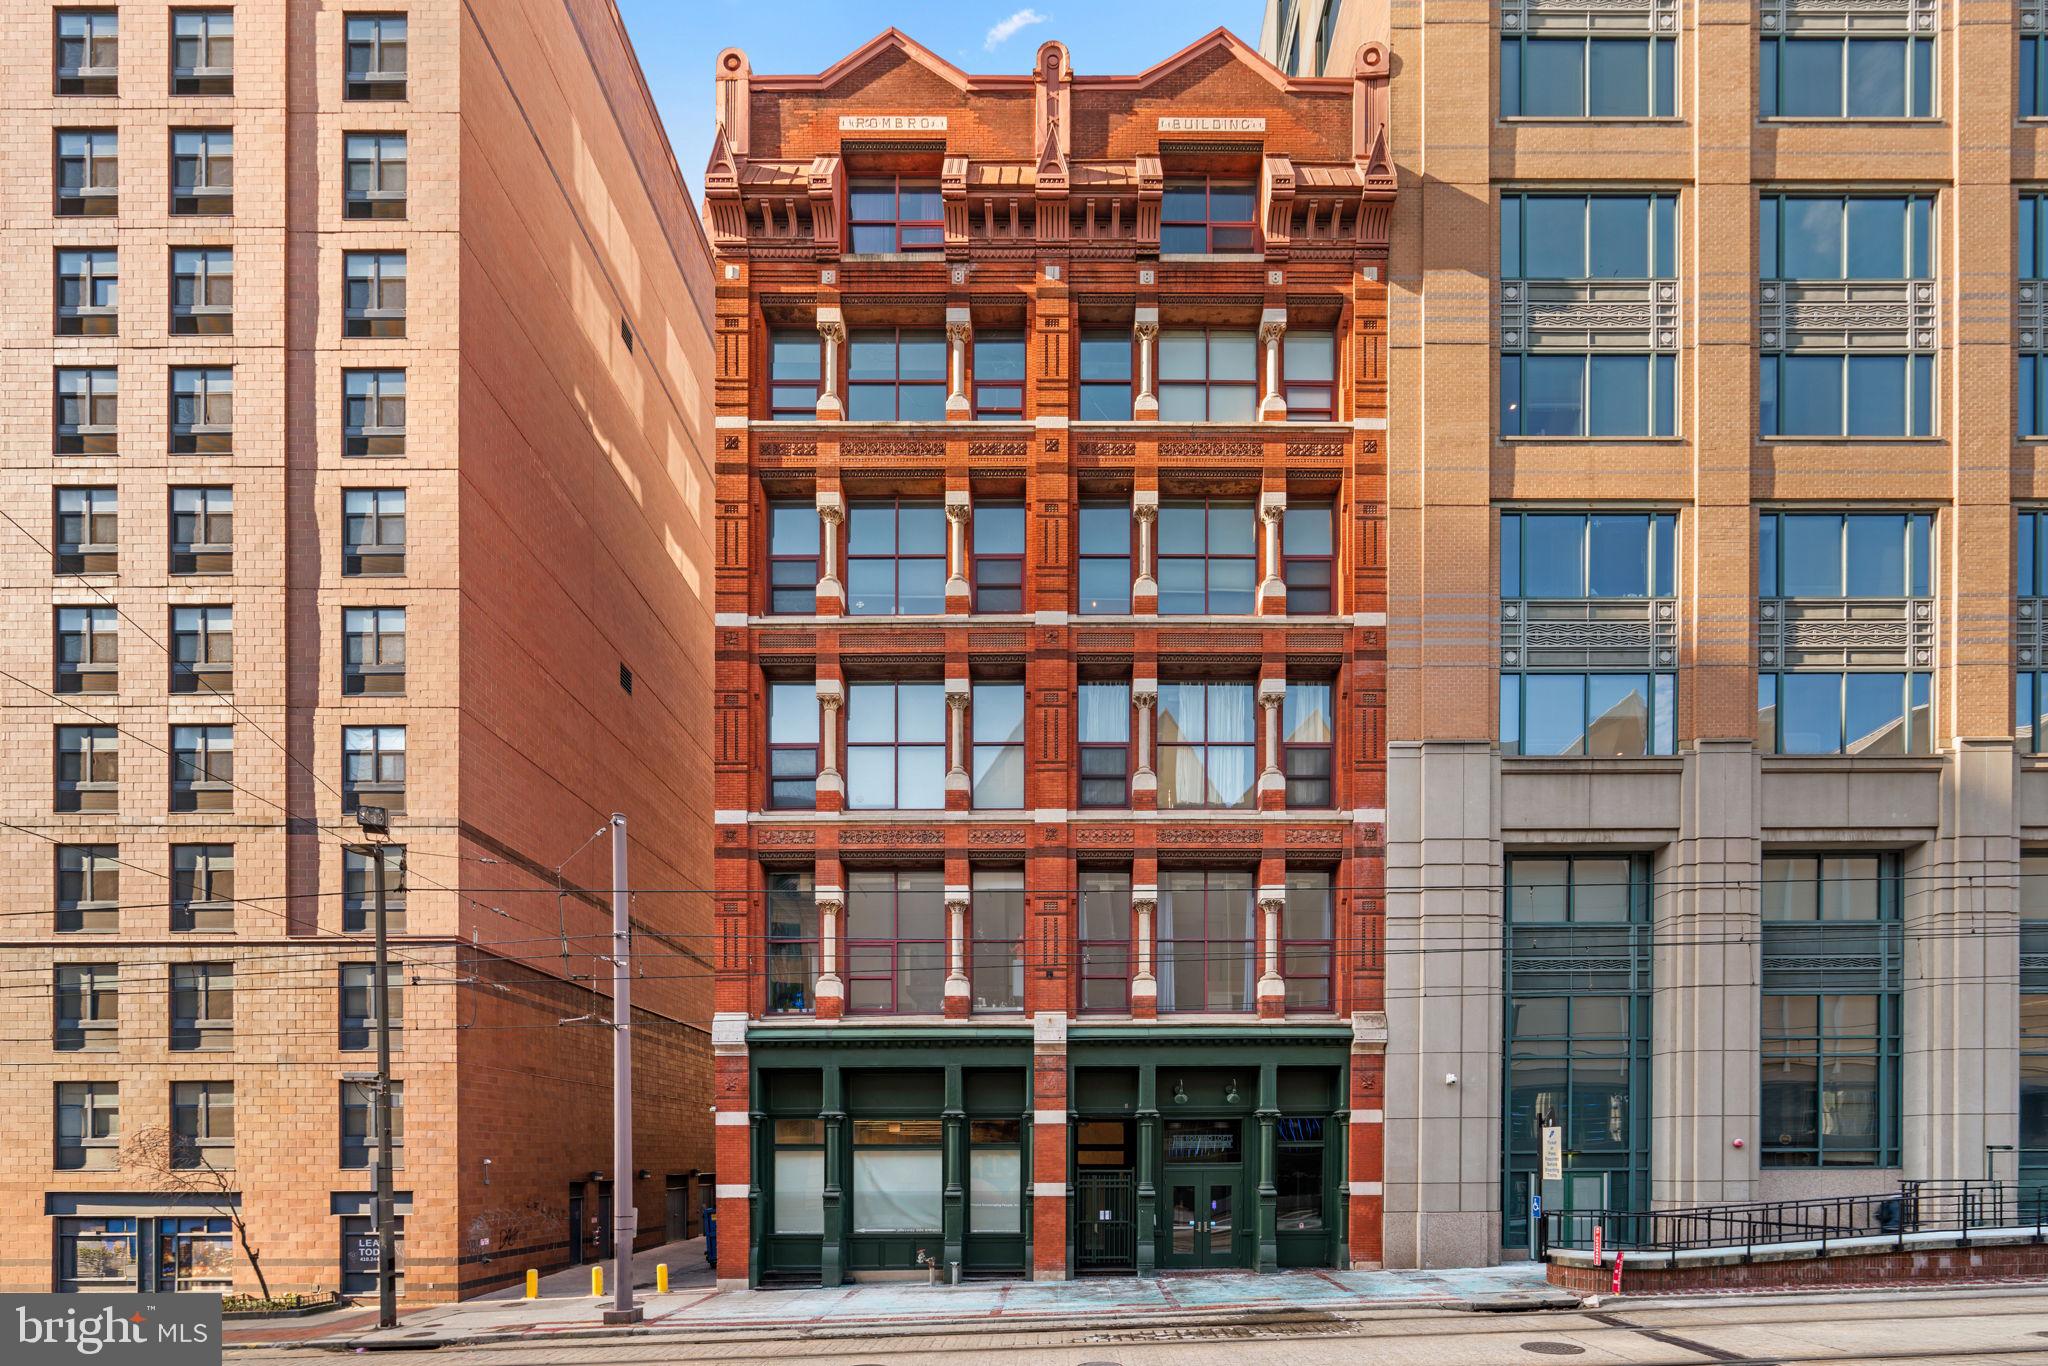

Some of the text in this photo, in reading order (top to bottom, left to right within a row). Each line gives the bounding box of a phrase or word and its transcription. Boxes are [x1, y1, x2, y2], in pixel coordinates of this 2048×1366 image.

[856, 118, 929, 128] ROMBRO
[1173, 119, 1249, 129] BUILDING
[359, 1239, 380, 1247] LEA
[359, 1248, 380, 1256] TOD
